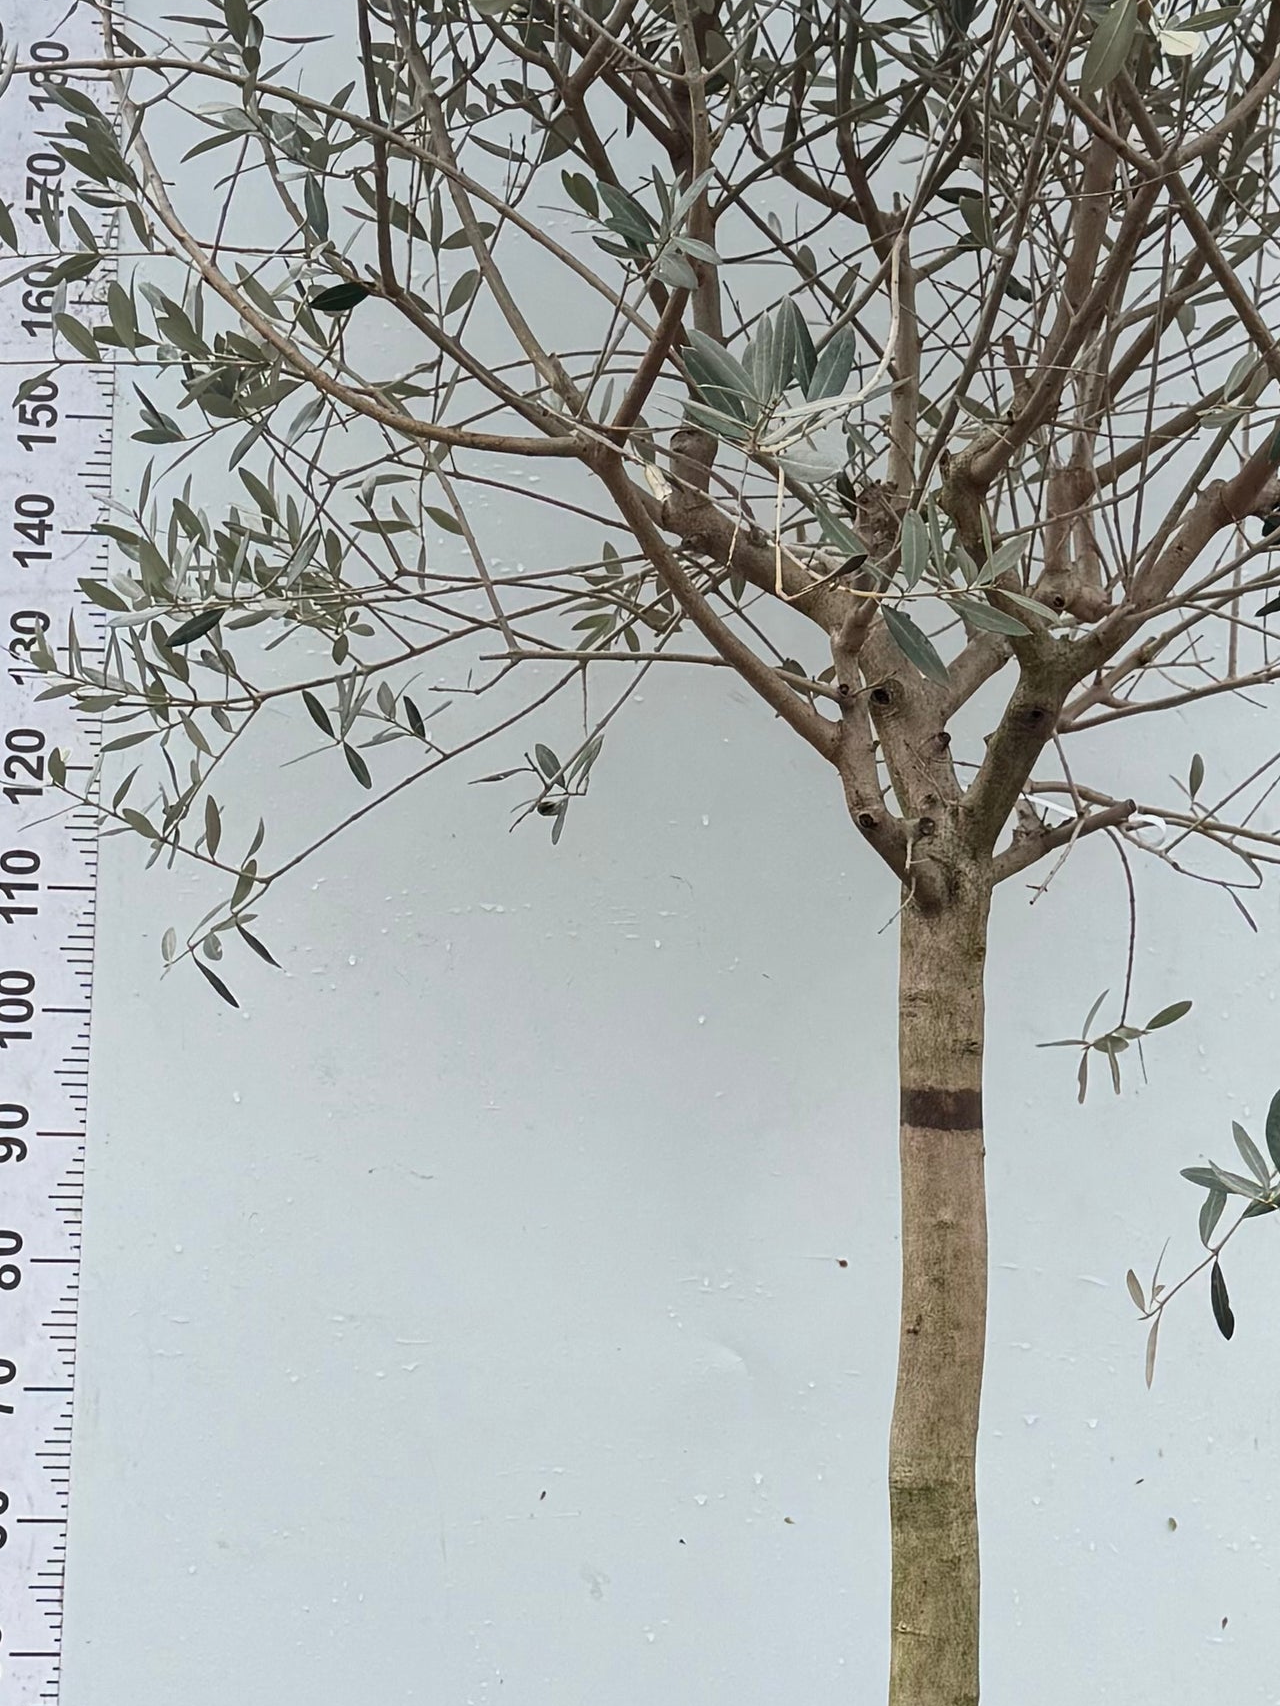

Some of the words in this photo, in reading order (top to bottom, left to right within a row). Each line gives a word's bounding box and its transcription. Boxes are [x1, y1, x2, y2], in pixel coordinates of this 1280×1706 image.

[28, 40, 69, 112] 180
[24, 153, 66, 225] 170
[17, 380, 59, 452] 150
[12, 494, 55, 568] 140
[7, 610, 51, 686] 130
[2, 728, 46, 805] 120
